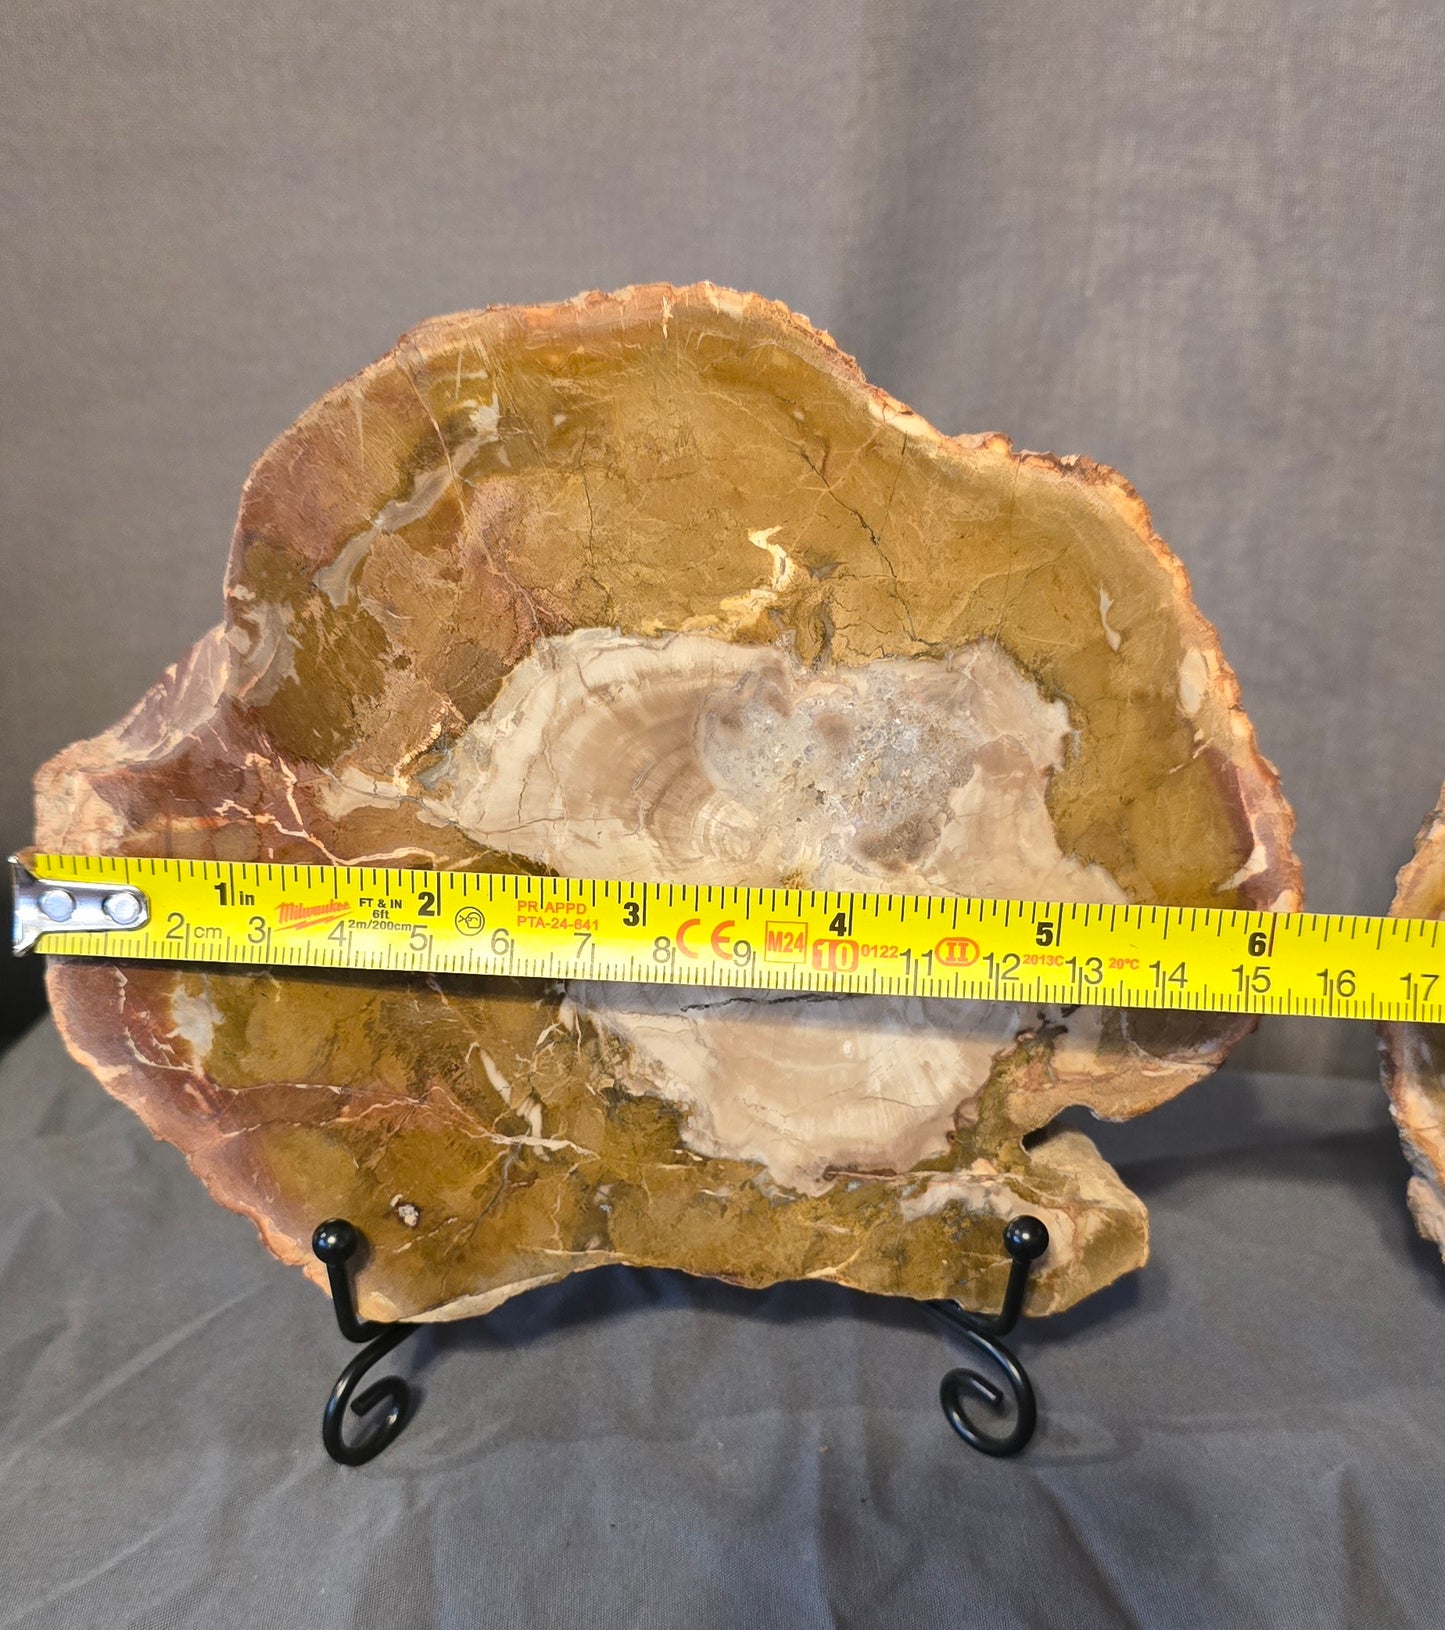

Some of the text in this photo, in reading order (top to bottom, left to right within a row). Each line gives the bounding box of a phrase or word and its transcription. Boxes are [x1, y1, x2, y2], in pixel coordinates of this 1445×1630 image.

[215, 882, 255, 906] 1 in
[359, 897, 402, 909] FT & IN
[418, 891, 435, 917] 2
[372, 909, 389, 919] 6ft
[517, 900, 587, 915] PR APPD
[623, 902, 640, 927] 3
[166, 912, 222, 939] 2 cm
[248, 916, 266, 943] 3
[328, 920, 346, 947] 4
[348, 919, 412, 932] 2m/200cm
[517, 916, 598, 931] PTA-24-641
[829, 912, 847, 937] 4
[1035, 922, 1053, 947] 5
[409, 925, 428, 951] 5
[490, 928, 510, 955] 6
[574, 932, 592, 958] 7
[652, 936, 671, 963] 8
[768, 930, 804, 952] M24
[861, 944, 898, 958] 0122
[1247, 932, 1267, 957] 6
[733, 940, 751, 967] 9
[900, 948, 933, 976] 11
[982, 952, 1021, 980] 12
[1023, 954, 1064, 966] 2013C
[1065, 956, 1103, 985] 13
[1149, 960, 1188, 988] 14
[1232, 964, 1271, 993] 15
[1316, 968, 1356, 997] 16
[1400, 972, 1440, 1001] 17
